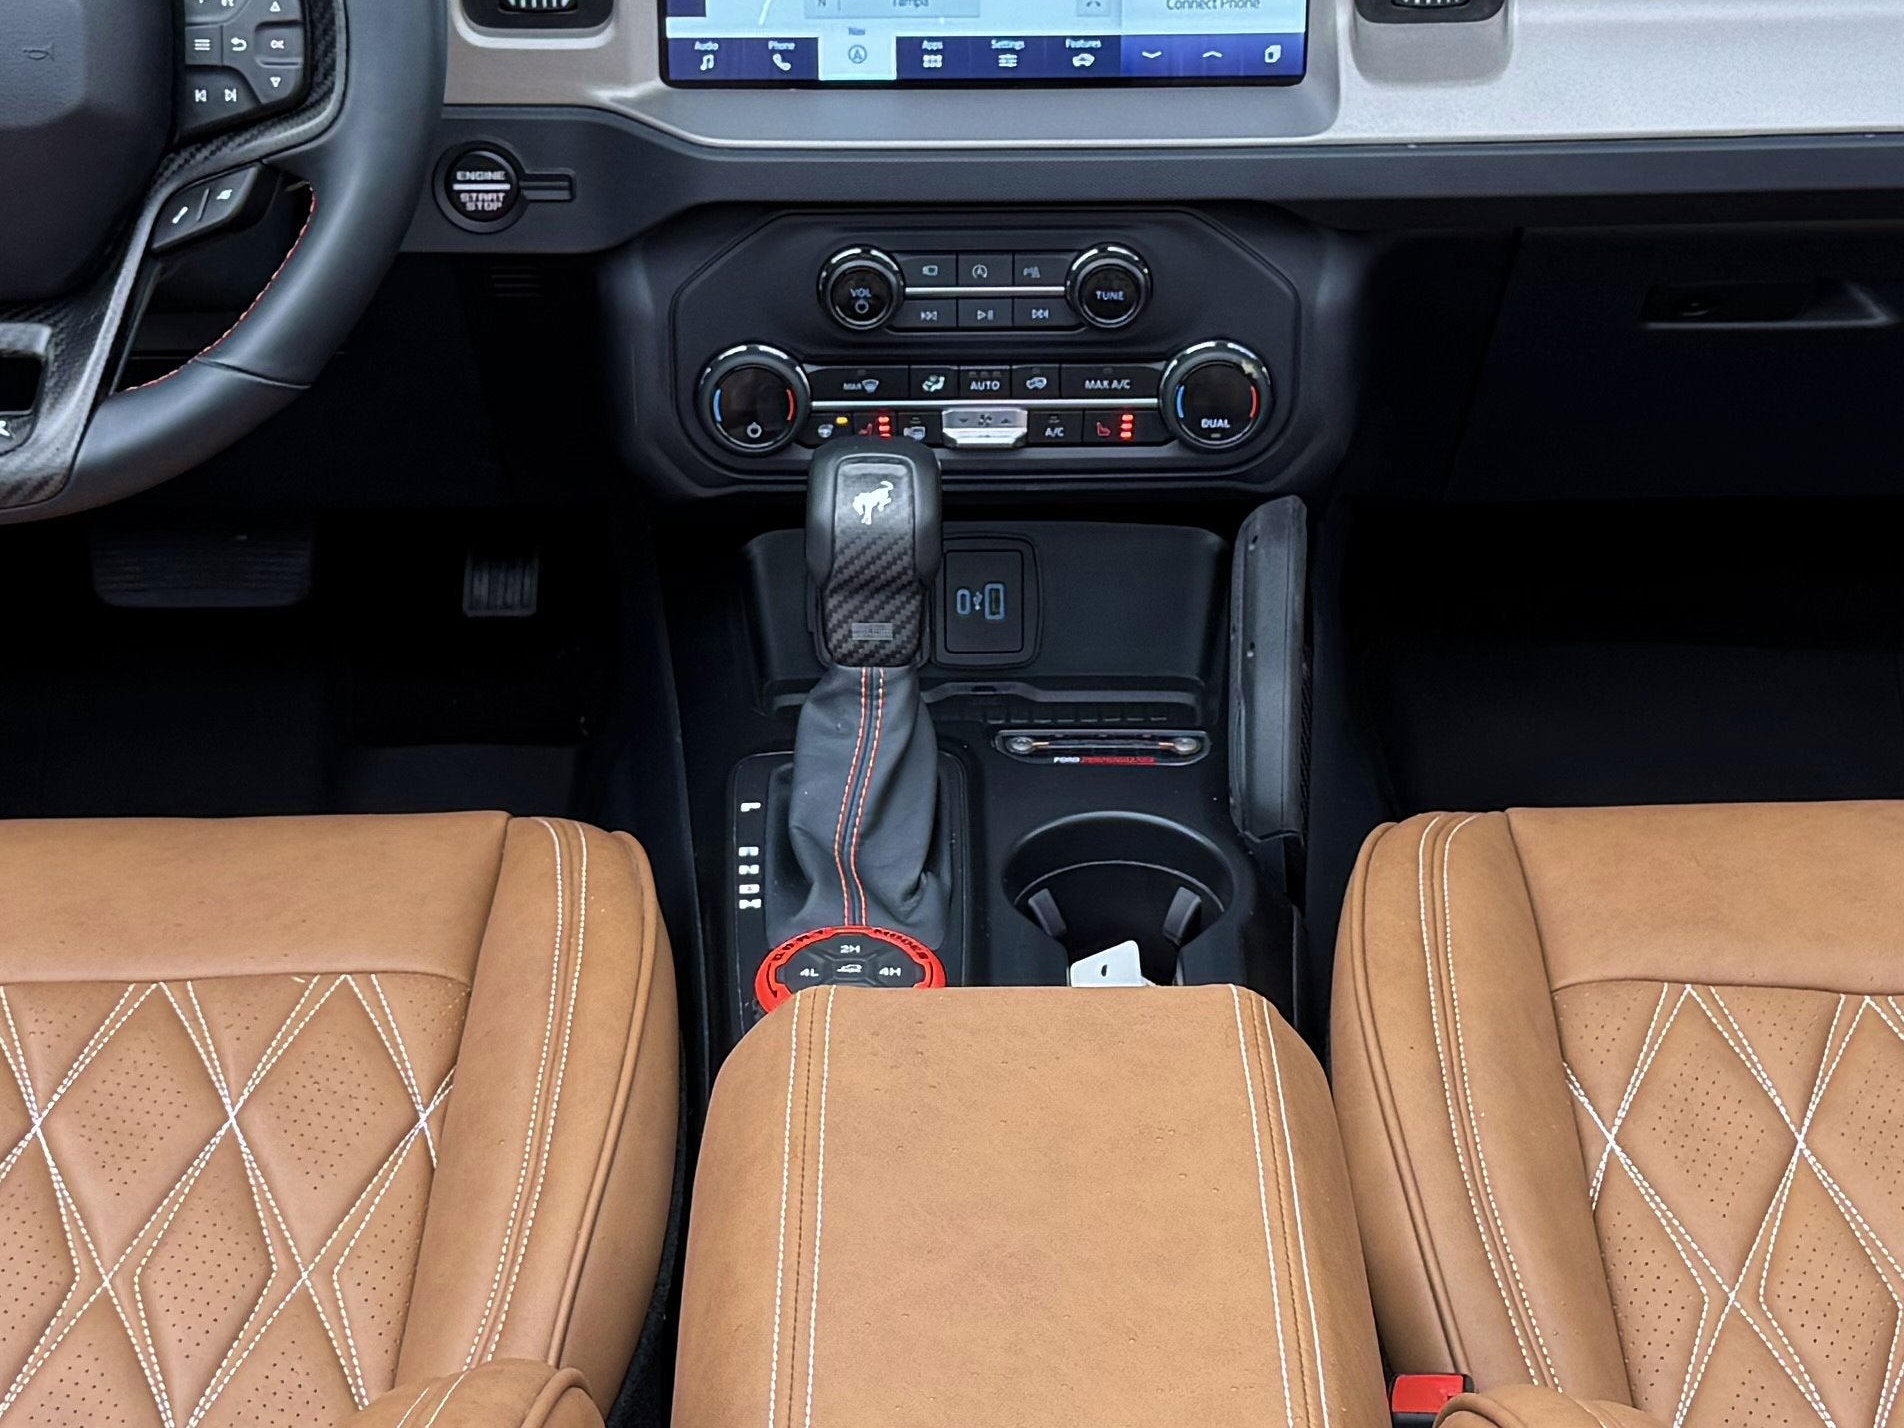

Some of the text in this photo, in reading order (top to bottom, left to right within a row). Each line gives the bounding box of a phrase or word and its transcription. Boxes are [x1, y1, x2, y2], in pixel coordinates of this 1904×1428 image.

[270, 39, 285, 49] OK
[768, 41, 795, 51] Phone
[922, 40, 943, 52] Apps
[456, 171, 506, 181] ENGINE
[460, 192, 505, 202] START
[466, 201, 502, 211] STOP
[850, 287, 872, 298] VOL
[1096, 290, 1124, 301] TUNE
[970, 380, 1000, 391] AUTO
[1111, 379, 1131, 390] A/C
[1201, 418, 1231, 428] DUAL
[1045, 426, 1065, 438] A/C
[840, 944, 861, 955] 2H
[799, 968, 820, 977] 4L
[879, 967, 902, 977] 4H
